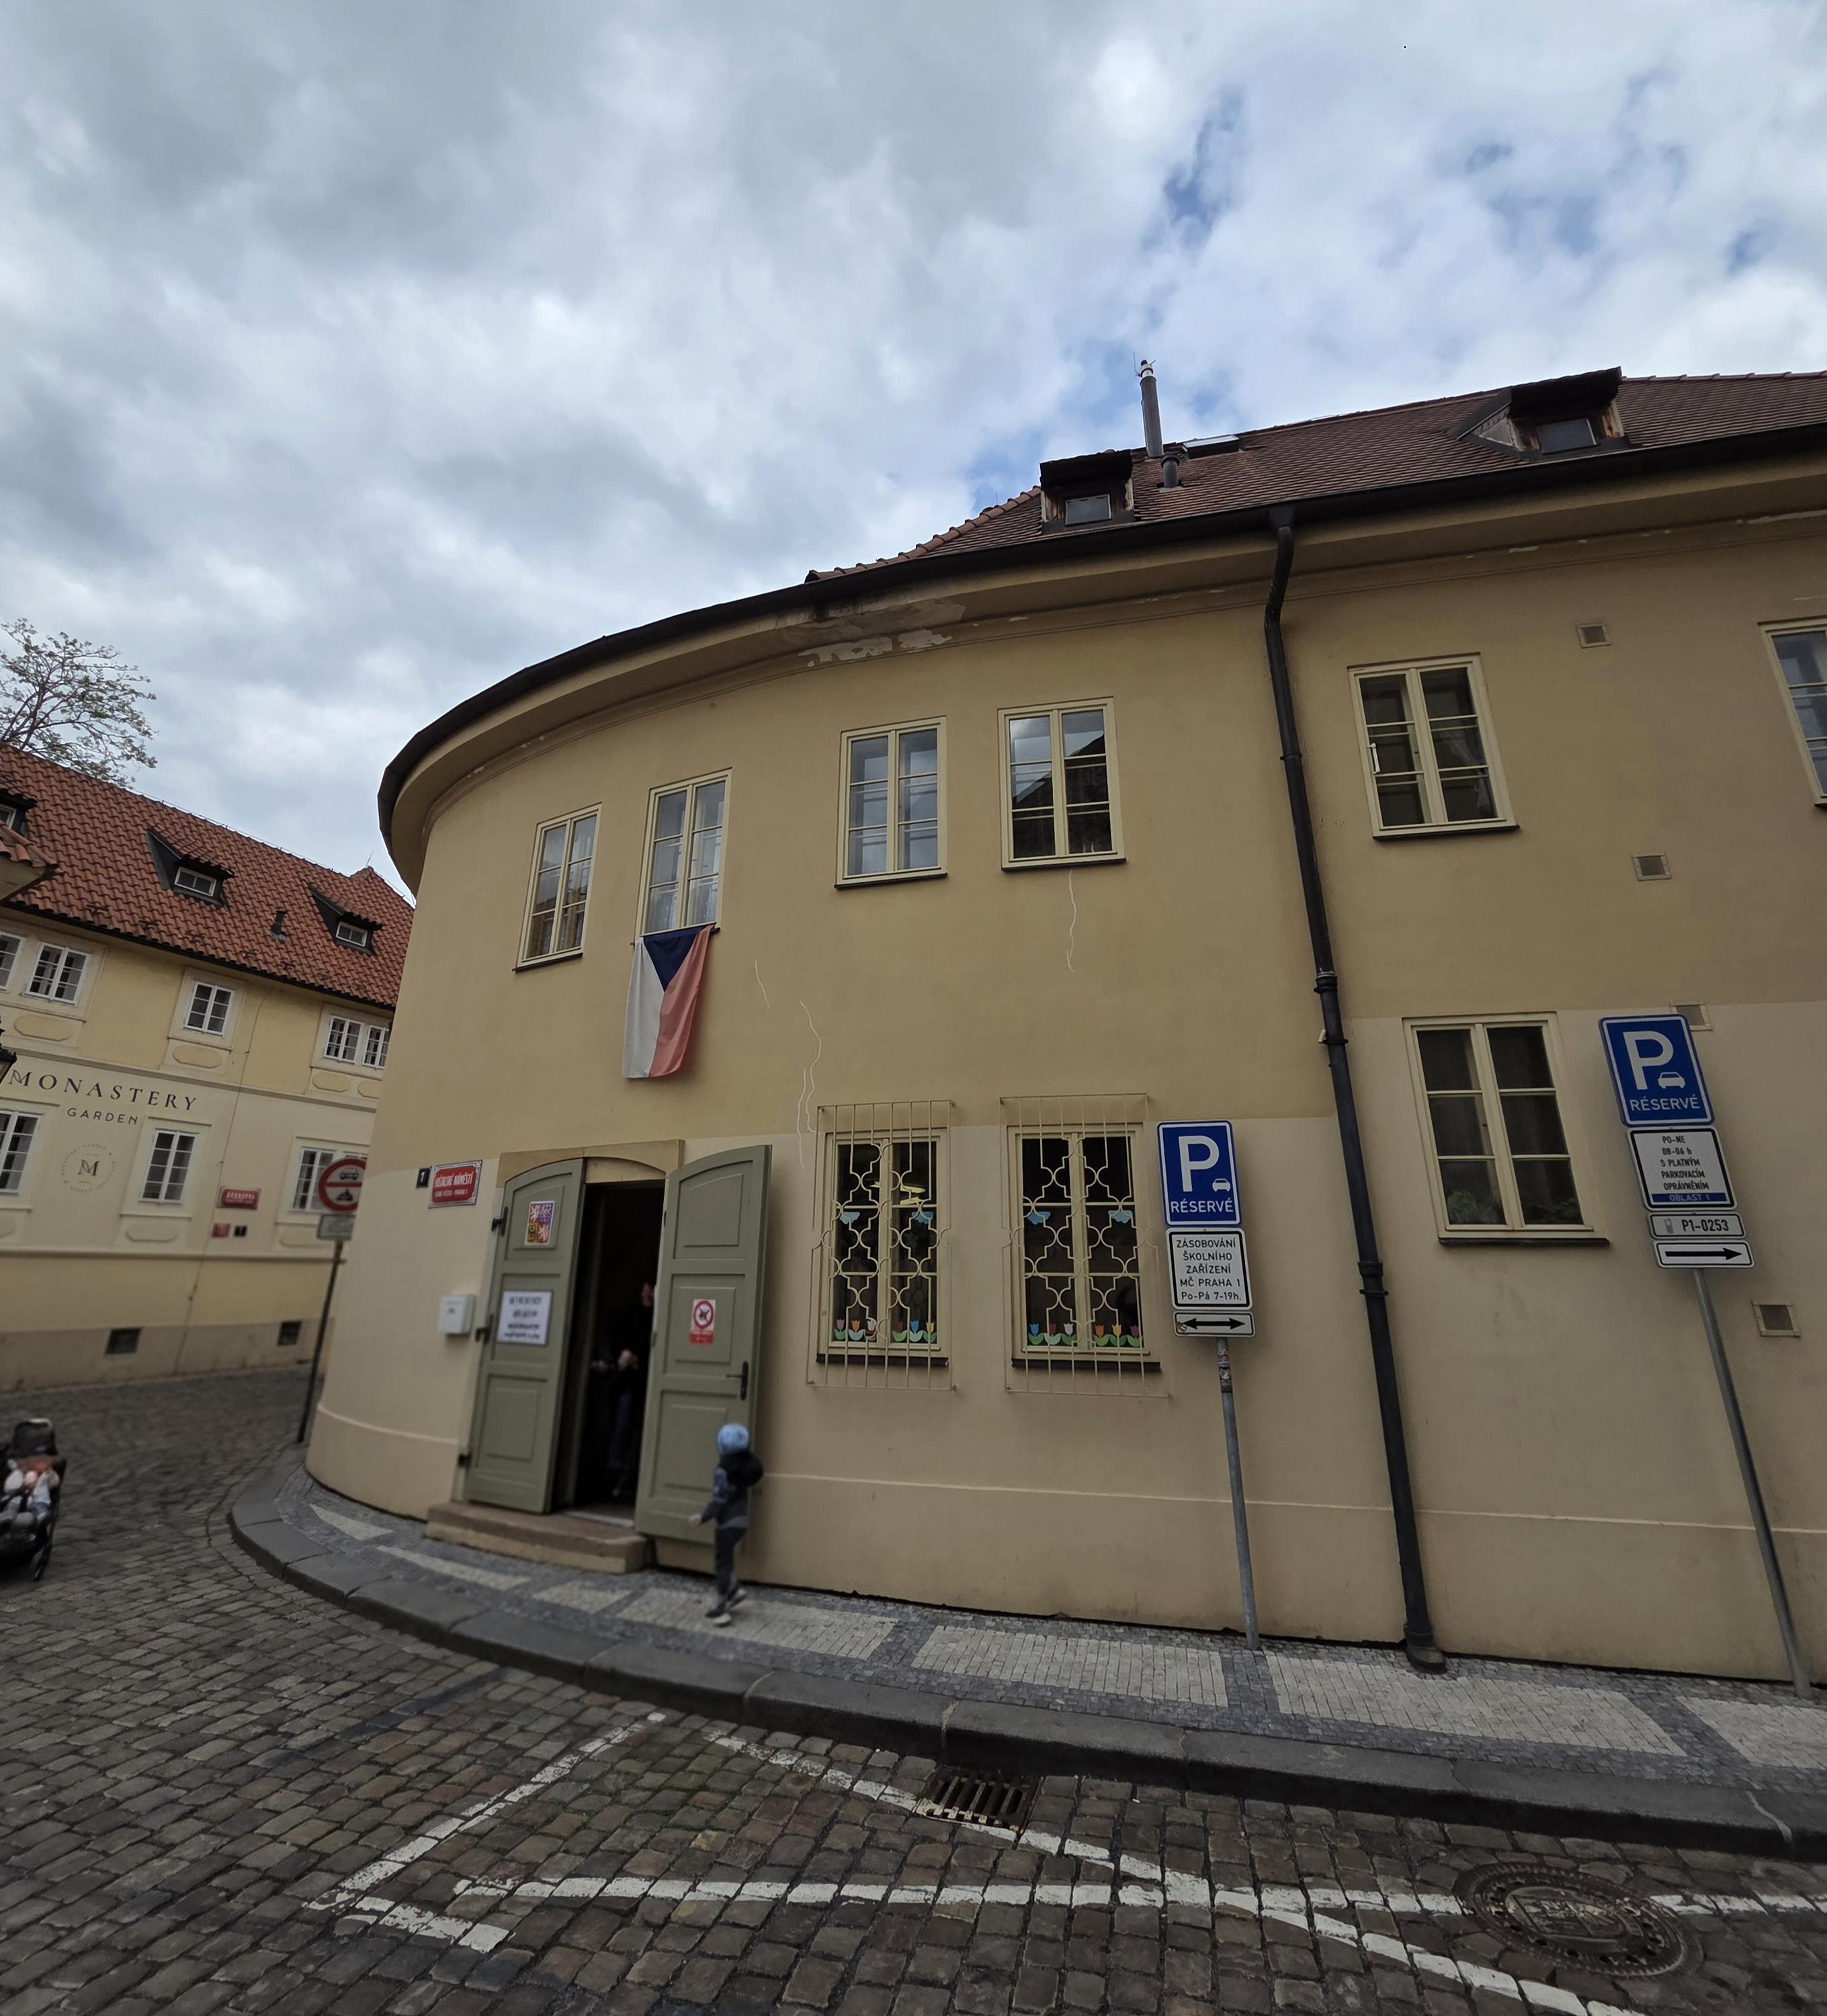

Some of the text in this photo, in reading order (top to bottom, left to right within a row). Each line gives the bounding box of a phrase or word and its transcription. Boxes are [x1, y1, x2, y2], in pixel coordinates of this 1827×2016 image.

[1623, 1030, 1674, 1090] P
[8, 1069, 198, 1111] MONASTERY
[1629, 1094, 1701, 1111] RÉSERVÉ
[67, 1107, 138, 1125] GARDEN
[1662, 1136, 1686, 1144] PO-NE
[1178, 1135, 1220, 1192] P
[1660, 1157, 1700, 1167] S PLATNÝM
[1661, 1168, 1705, 1179] PARKOVACÍM
[1663, 1180, 1709, 1190] OPRÁVNĚNÍM
[1669, 1193, 1702, 1202] OBLAST
[1171, 1198, 1234, 1213] RÉSERVÉ
[1681, 1218, 1730, 1232] P1-0253
[1177, 1238, 1236, 1248] ZÁSOBOVÁNÍ
[1183, 1251, 1232, 1261] ŠKOLNÍHO
[1186, 1263, 1231, 1274] ZAŘÍZENÍ
[1180, 1277, 1240, 1287] MČ PRAHA 1
[1181, 1292, 1242, 1300] Po-Pá 7-19h.
